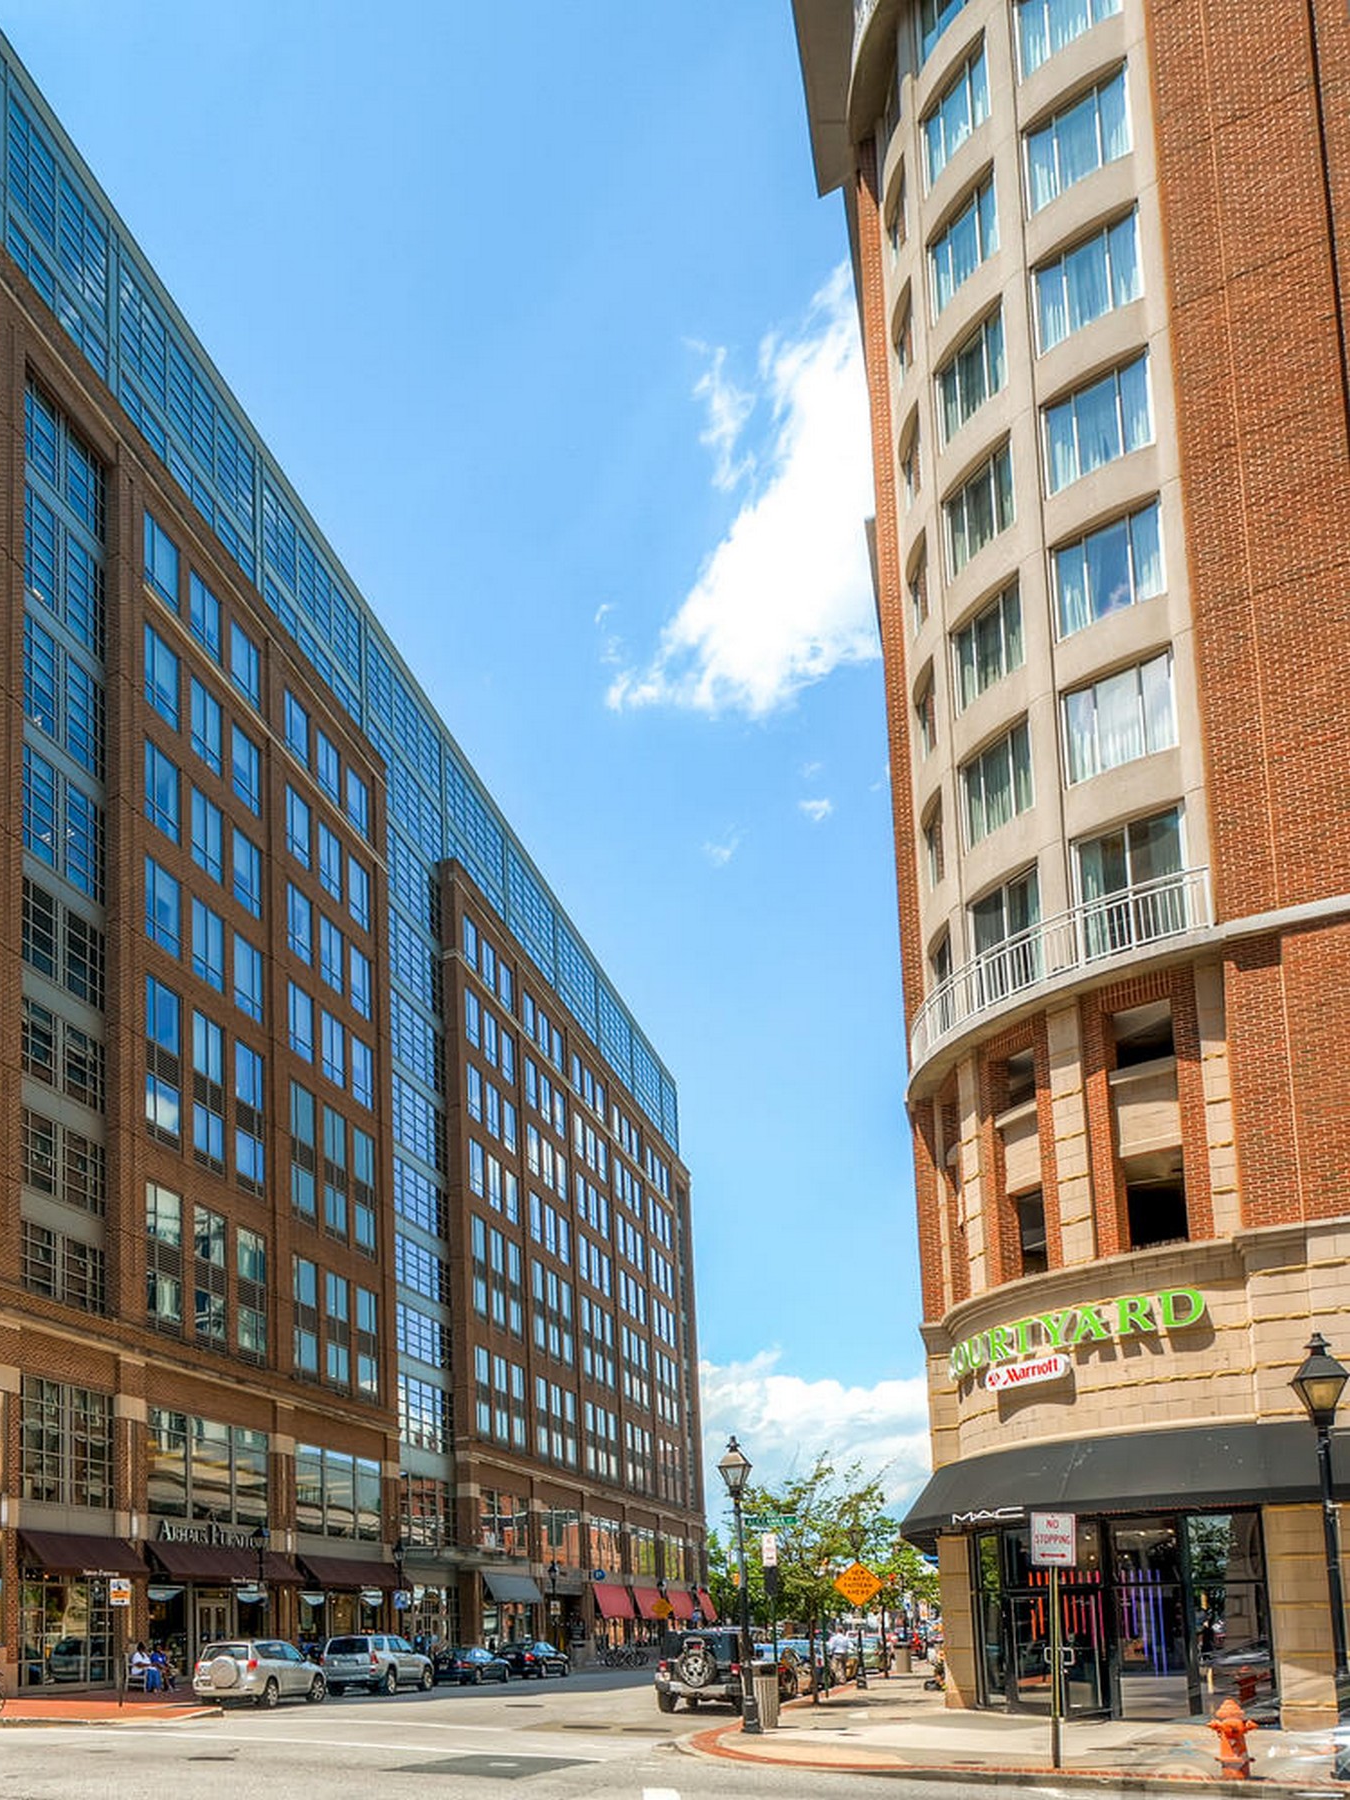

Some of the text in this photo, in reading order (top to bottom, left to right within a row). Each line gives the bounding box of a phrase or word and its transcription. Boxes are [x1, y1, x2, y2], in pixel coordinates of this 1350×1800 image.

[1002, 1357, 1058, 1386] Marriott
[951, 1506, 1025, 1525] MAC
[1045, 1519, 1060, 1530] NO
[1034, 1534, 1071, 1546] STOPPING
